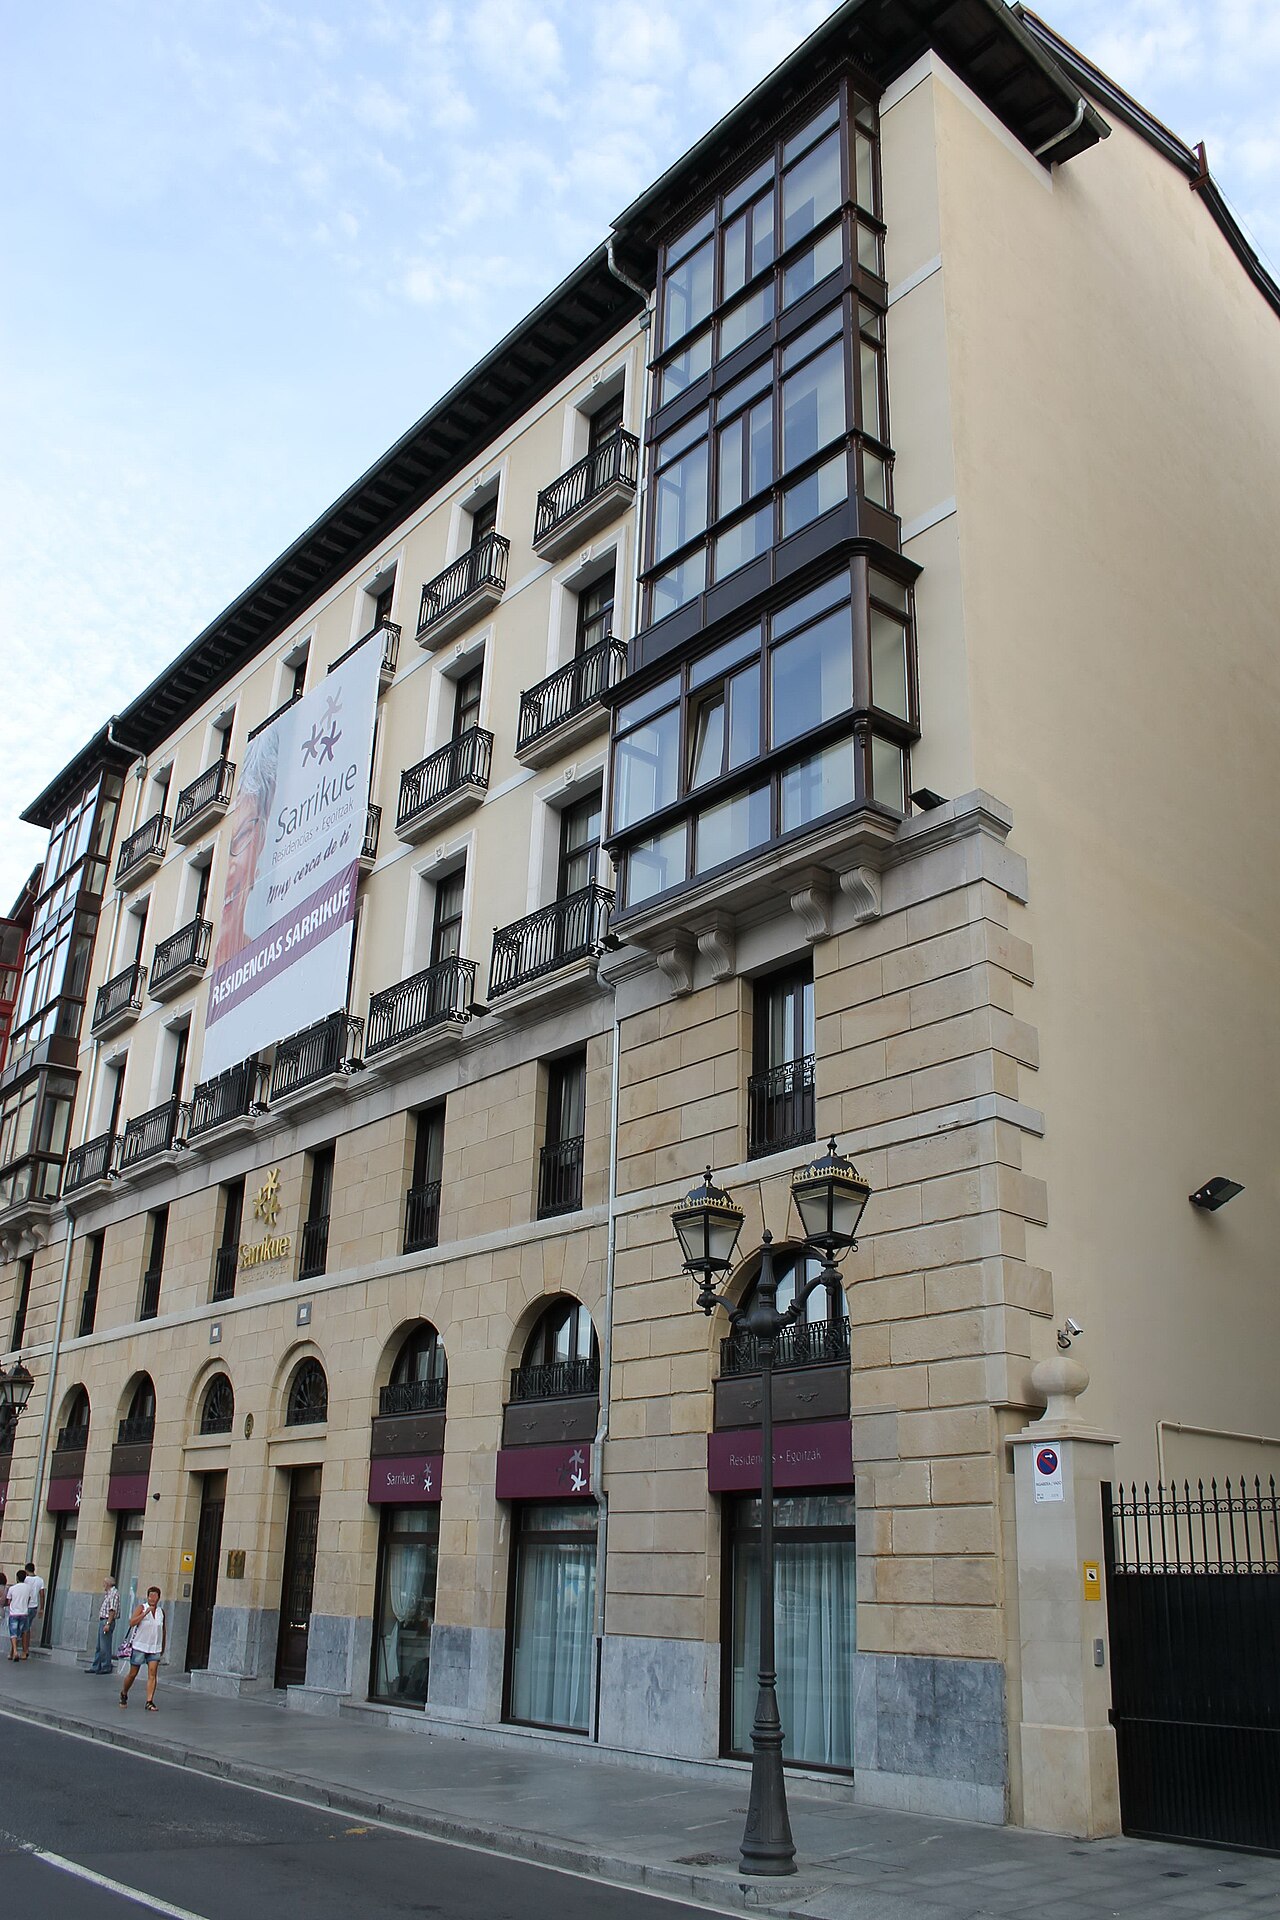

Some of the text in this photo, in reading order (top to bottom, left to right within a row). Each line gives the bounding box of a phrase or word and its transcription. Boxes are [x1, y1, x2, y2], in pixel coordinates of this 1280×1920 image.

[271, 797, 354, 866] Residencias Egoitzak
[275, 763, 357, 843] Sarrikue
[266, 822, 352, 907] Muy cerca de ti
[211, 882, 351, 1008] RESIDENCIAS SARRIKUE
[238, 1234, 291, 1269] Sarrikue
[386, 1471, 415, 1486] Sarrikue
[729, 1447, 822, 1467] Residencs Egoitzak
